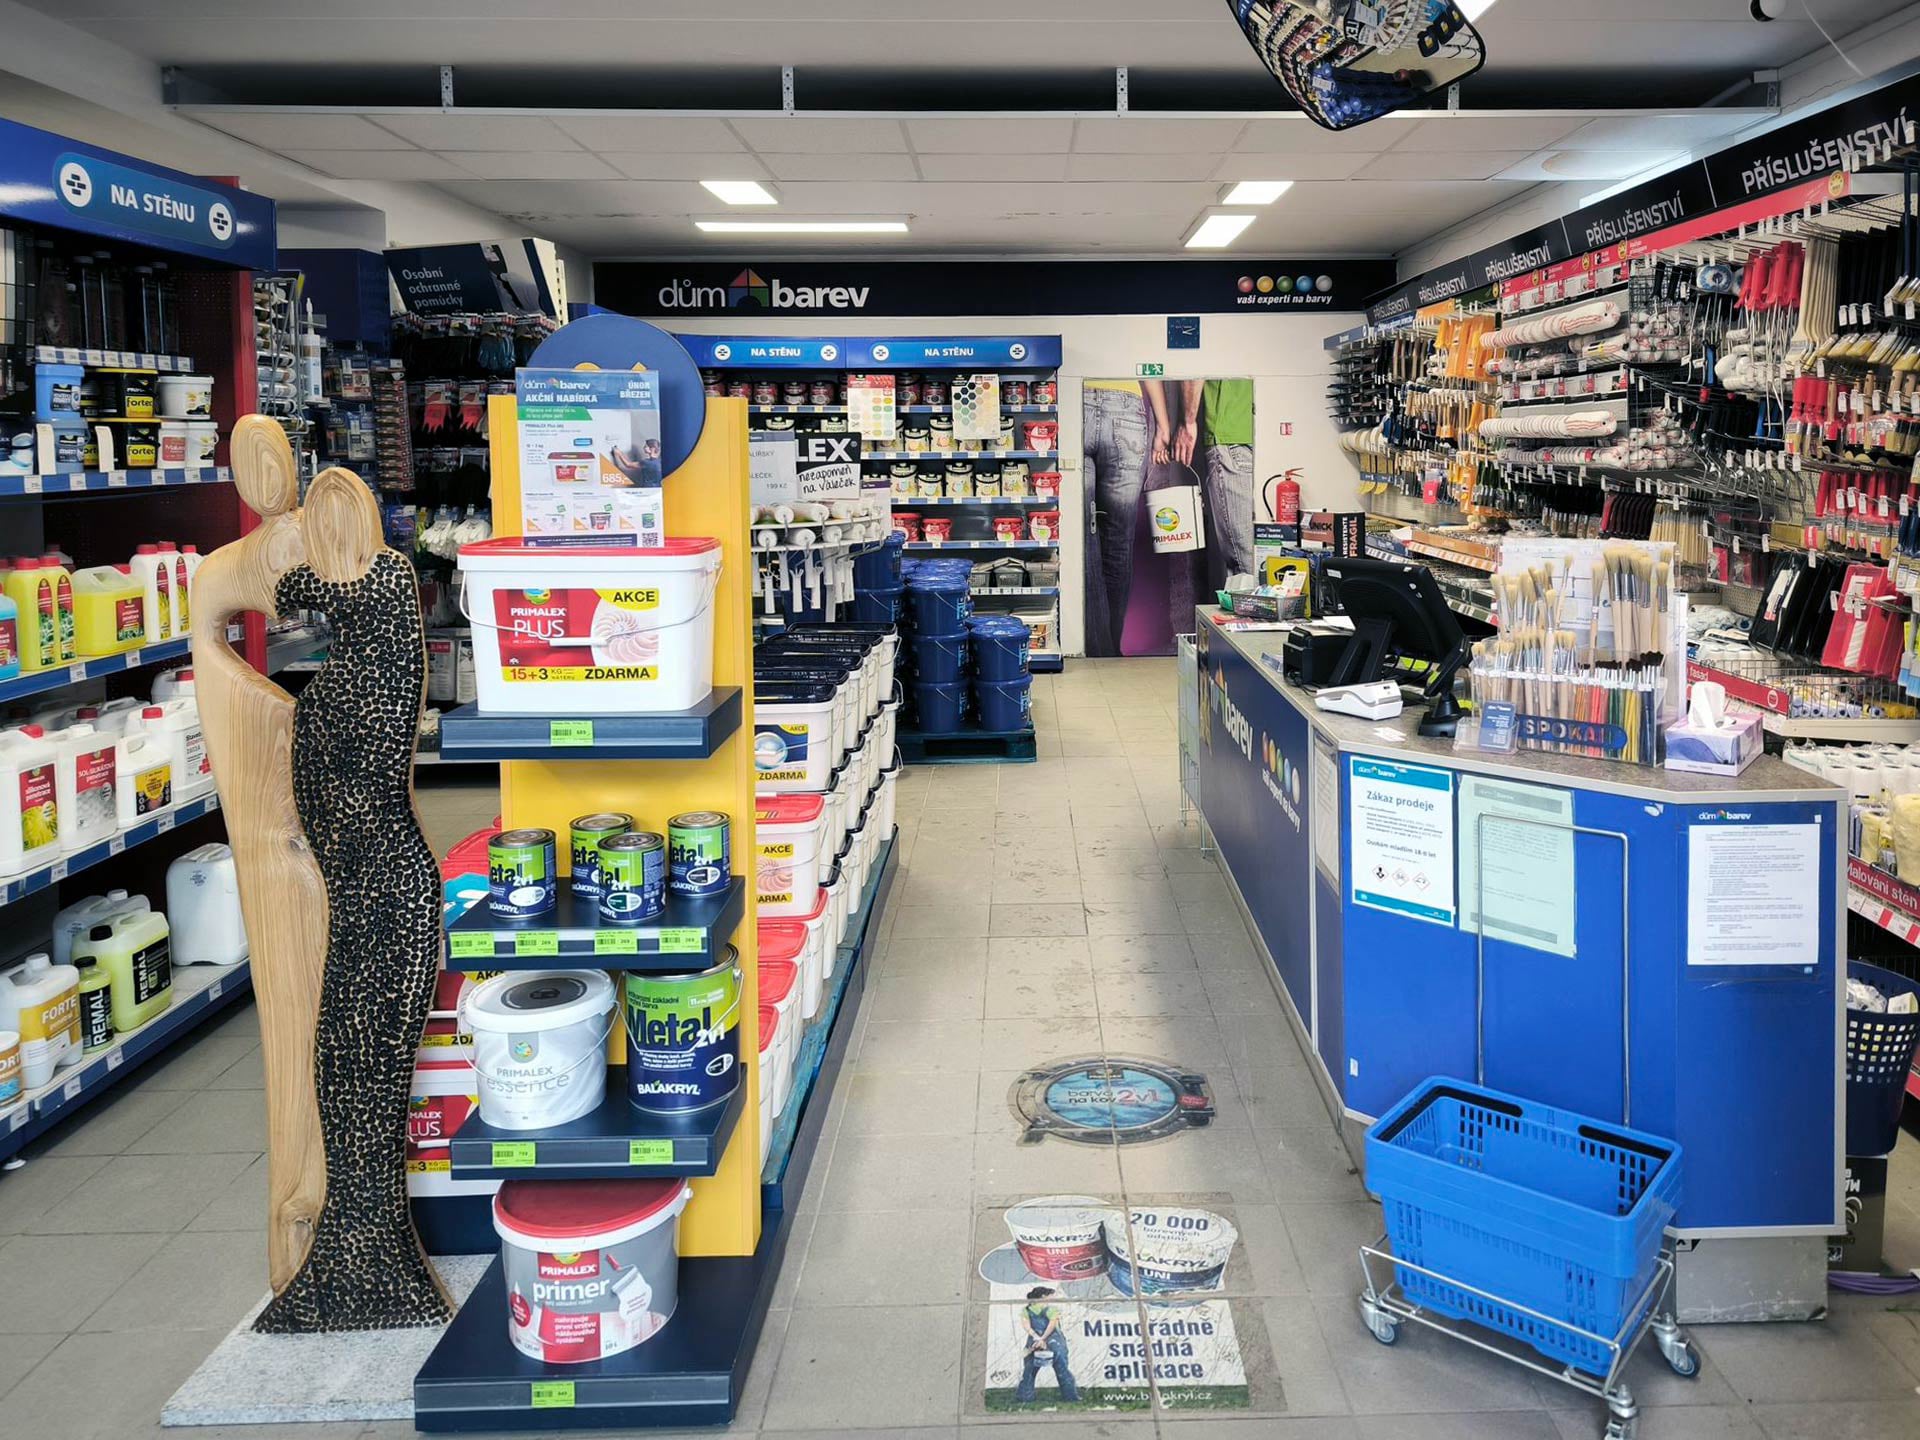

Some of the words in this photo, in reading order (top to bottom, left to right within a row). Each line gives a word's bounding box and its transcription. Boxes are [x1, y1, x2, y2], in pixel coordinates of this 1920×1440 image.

[1741, 107, 1909, 194] PŘÍSLUŠENSTVÍ
[111, 183, 138, 209] NA
[143, 193, 195, 223] STĚNU
[1585, 190, 1684, 247] PŘÍSLUŠENSTVÍ
[1485, 240, 1551, 281] PŘÍSLUŠENSTVÍ
[402, 268, 443, 281] Osobní
[409, 281, 461, 295] ochranné
[658, 279, 725, 308] dům
[772, 279, 869, 307] barev
[1419, 276, 1468, 302] PŘÍSLUŠENSTVÍ
[414, 294, 463, 309] pomůcky
[1237, 295, 1255, 305] vaši
[1257, 294, 1290, 305] experti
[1292, 296, 1304, 304] na
[1305, 294, 1332, 305] barvy
[751, 348, 766, 357] NA
[769, 347, 801, 357] STĚNU
[924, 348, 940, 357] NA
[942, 347, 974, 357] STĚNU
[524, 380, 546, 389] dům
[560, 380, 591, 390] barev
[525, 392, 554, 402] AKČNÍ
[557, 392, 598, 403] NABÍDKA
[620, 390, 651, 398] BŘEZEN
[803, 484, 817, 494] na
[1152, 532, 1192, 545] PRIMALEX
[1349, 516, 1358, 557] FRAGIL
[614, 591, 655, 603] AKCE
[511, 608, 564, 616] PRIMALEX
[514, 619, 564, 637] PLUS
[585, 668, 650, 680] ZDARMA
[759, 771, 804, 781] ZDARMA
[1366, 790, 1393, 804] Zákaz
[1396, 798, 1434, 811] prodeje
[1699, 812, 1717, 820] dům
[1726, 812, 1751, 820] barev
[670, 843, 703, 863] etal
[764, 845, 791, 853] AKCE
[490, 864, 522, 884] etal
[140, 950, 150, 1000] REMAL
[42, 994, 77, 1025] FORTE
[90, 989, 107, 1046] REMAL
[628, 1006, 711, 1048] Metal
[496, 1066, 553, 1078] PRIMALEX
[487, 1074, 569, 1093] essence
[1068, 1089, 1113, 1097] barva
[1117, 1089, 1161, 1105] 2v1
[1131, 1213, 1157, 1225] 20
[1167, 1216, 1209, 1231] 000
[1115, 1246, 1210, 1268] BLAKRYL
[541, 1265, 597, 1276] PRIMALEX
[1143, 1268, 1171, 1280] UNI
[533, 1279, 610, 1302] primer
[1083, 1318, 1214, 1337] Mimořádně
[1109, 1338, 1193, 1358] snadná
[1104, 1361, 1204, 1382] aplikace
[1103, 1390, 1212, 1401] www.bakryl.cz
